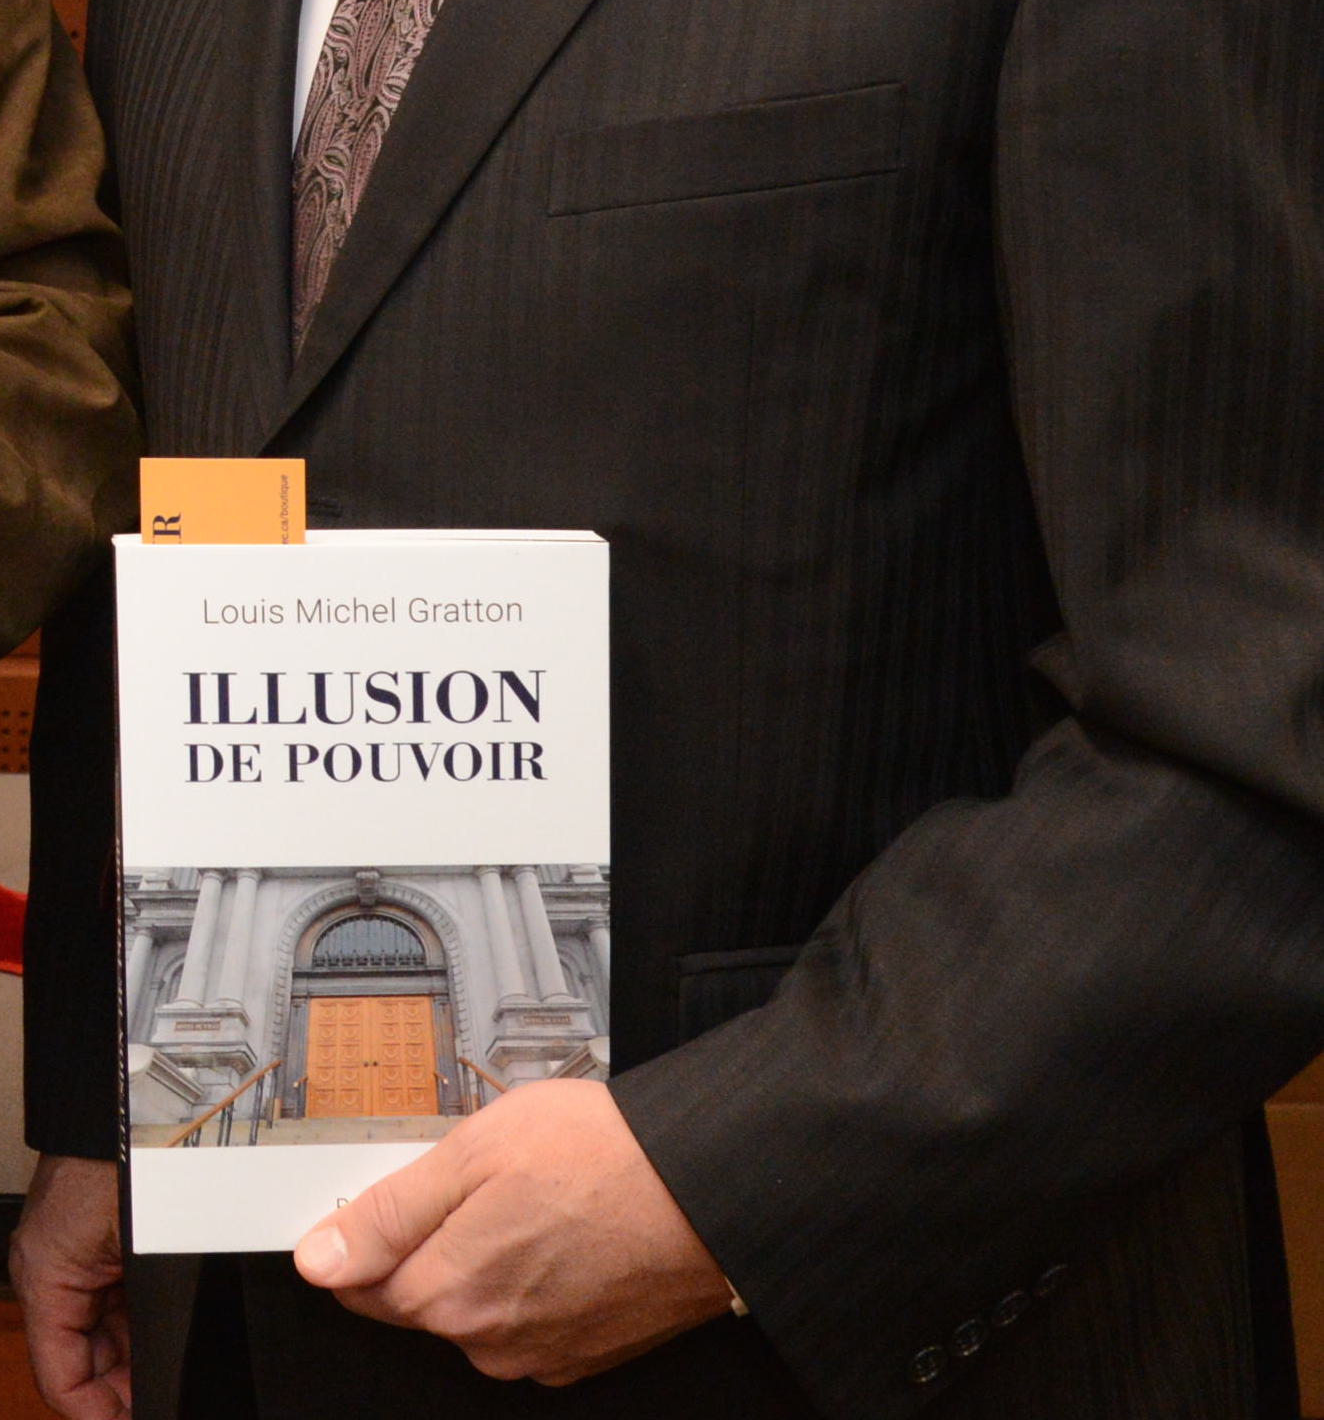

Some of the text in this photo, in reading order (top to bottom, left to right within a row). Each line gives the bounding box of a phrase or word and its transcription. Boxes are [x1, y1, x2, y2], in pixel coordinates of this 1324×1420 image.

[152, 512, 182, 545] R
[204, 597, 522, 624] Louis Michel Gratton
[182, 670, 547, 725] ILLUSION
[184, 741, 548, 783] DE POUVOIR
